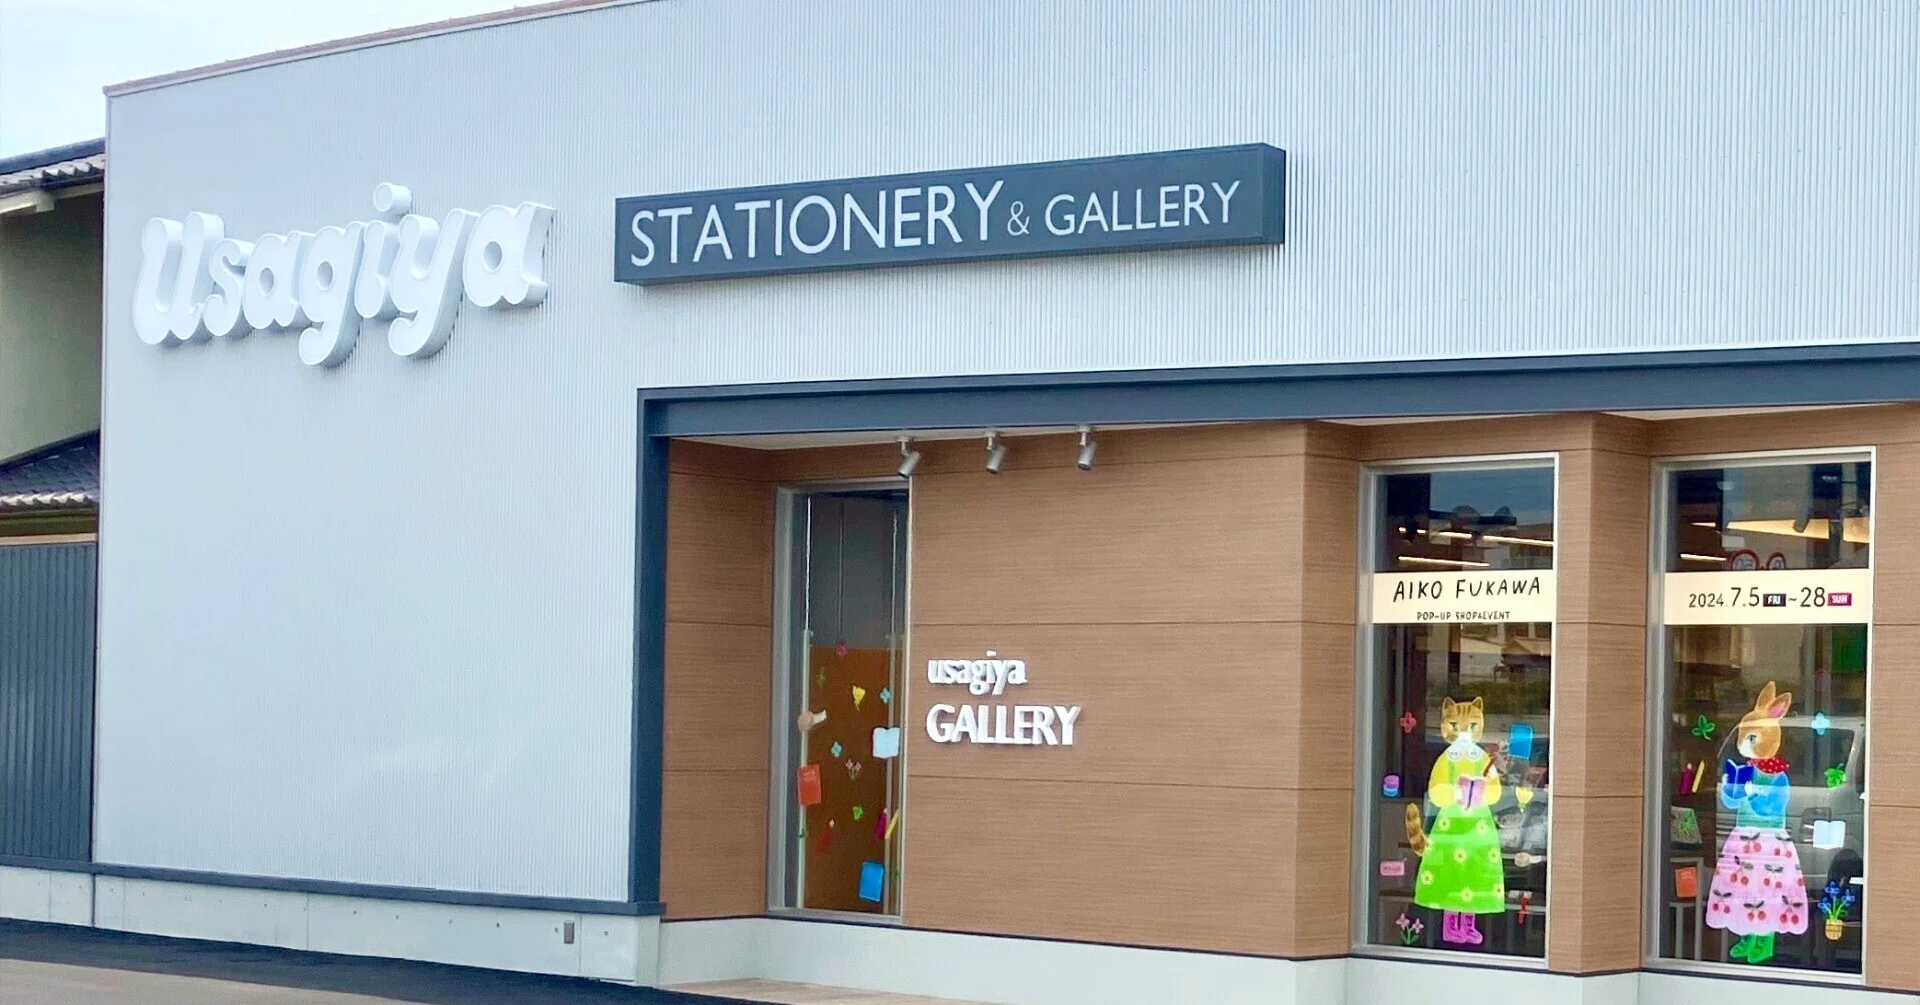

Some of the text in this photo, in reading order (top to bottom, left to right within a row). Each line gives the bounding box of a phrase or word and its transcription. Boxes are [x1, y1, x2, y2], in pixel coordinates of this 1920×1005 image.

[630, 180, 1241, 268] STATIONERY & GALLERY
[1393, 576, 1541, 602] AIKO FUKAWA
[1416, 611, 1452, 620] POP-UP
[927, 650, 1028, 695] usagiya
[926, 703, 1081, 745] GALLERY
